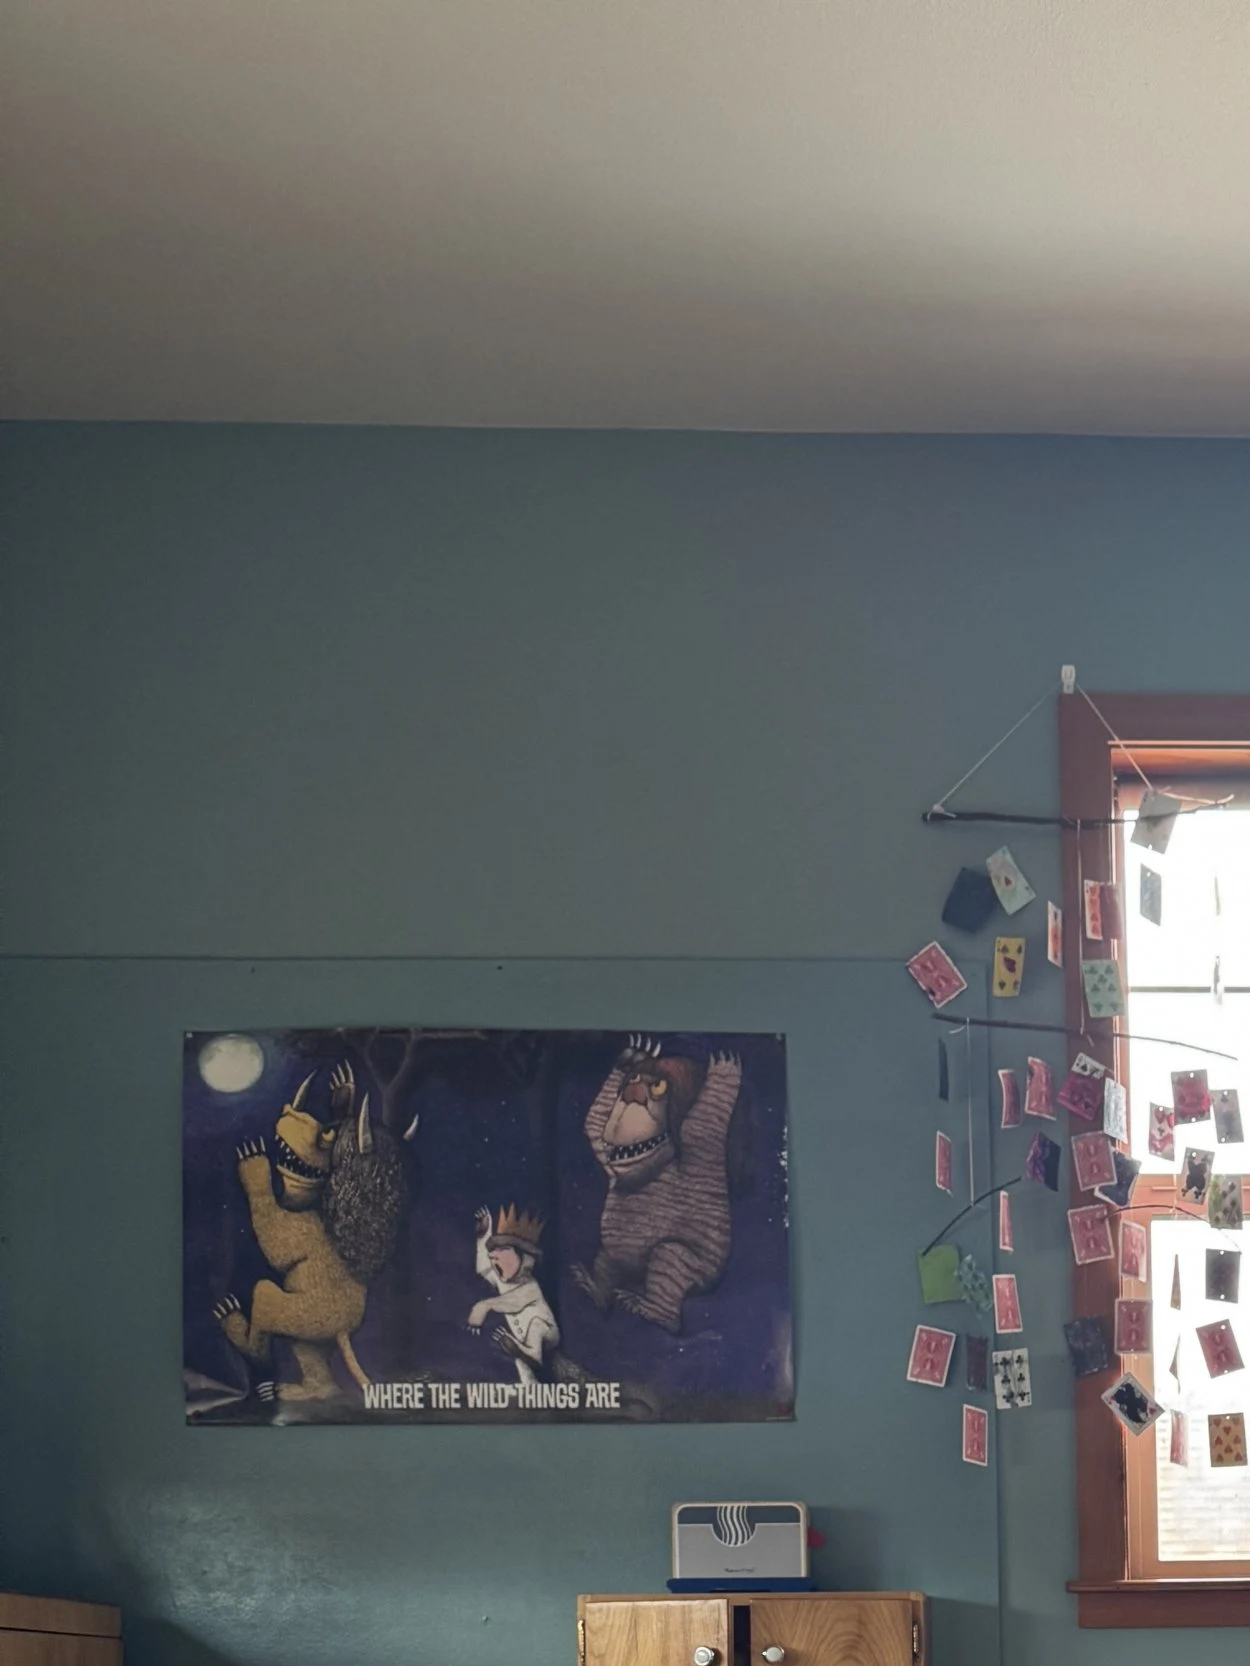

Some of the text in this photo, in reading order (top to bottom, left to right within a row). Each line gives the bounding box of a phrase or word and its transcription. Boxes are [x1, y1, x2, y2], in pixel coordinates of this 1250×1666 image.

[363, 1382, 621, 1409] WHERE THE WILD THINGS ARE
